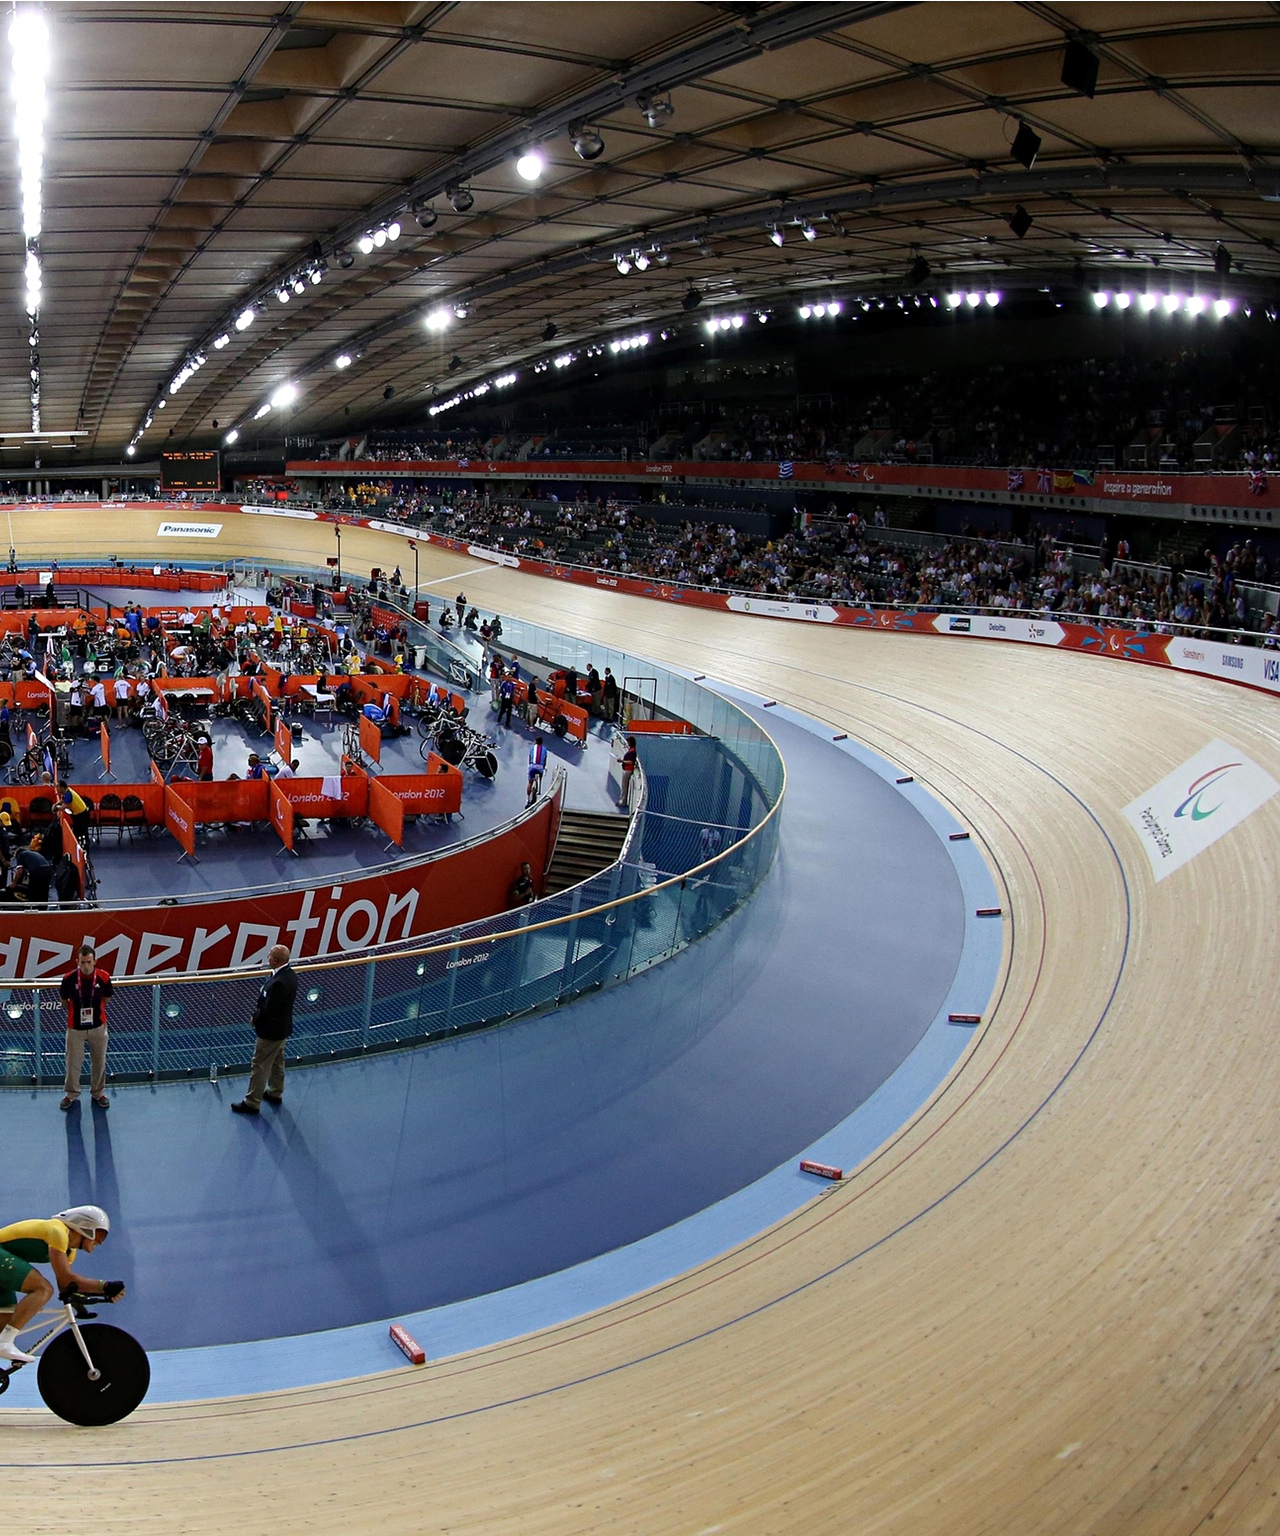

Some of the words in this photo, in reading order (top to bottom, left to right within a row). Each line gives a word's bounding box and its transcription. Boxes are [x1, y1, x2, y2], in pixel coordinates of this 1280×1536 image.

[1103, 480, 1126, 496] Inspire
[1132, 480, 1172, 498] generation
[163, 525, 215, 534] Panasonic
[1222, 654, 1243, 669] SAMSUNG
[1264, 658, 1280, 683] VISA
[288, 792, 324, 803] London
[392, 789, 422, 799] ondon
[424, 788, 446, 799] 2012
[446, 957, 472, 969] London
[473, 952, 489, 963] 2012
[40, 1001, 62, 1010] 2012
